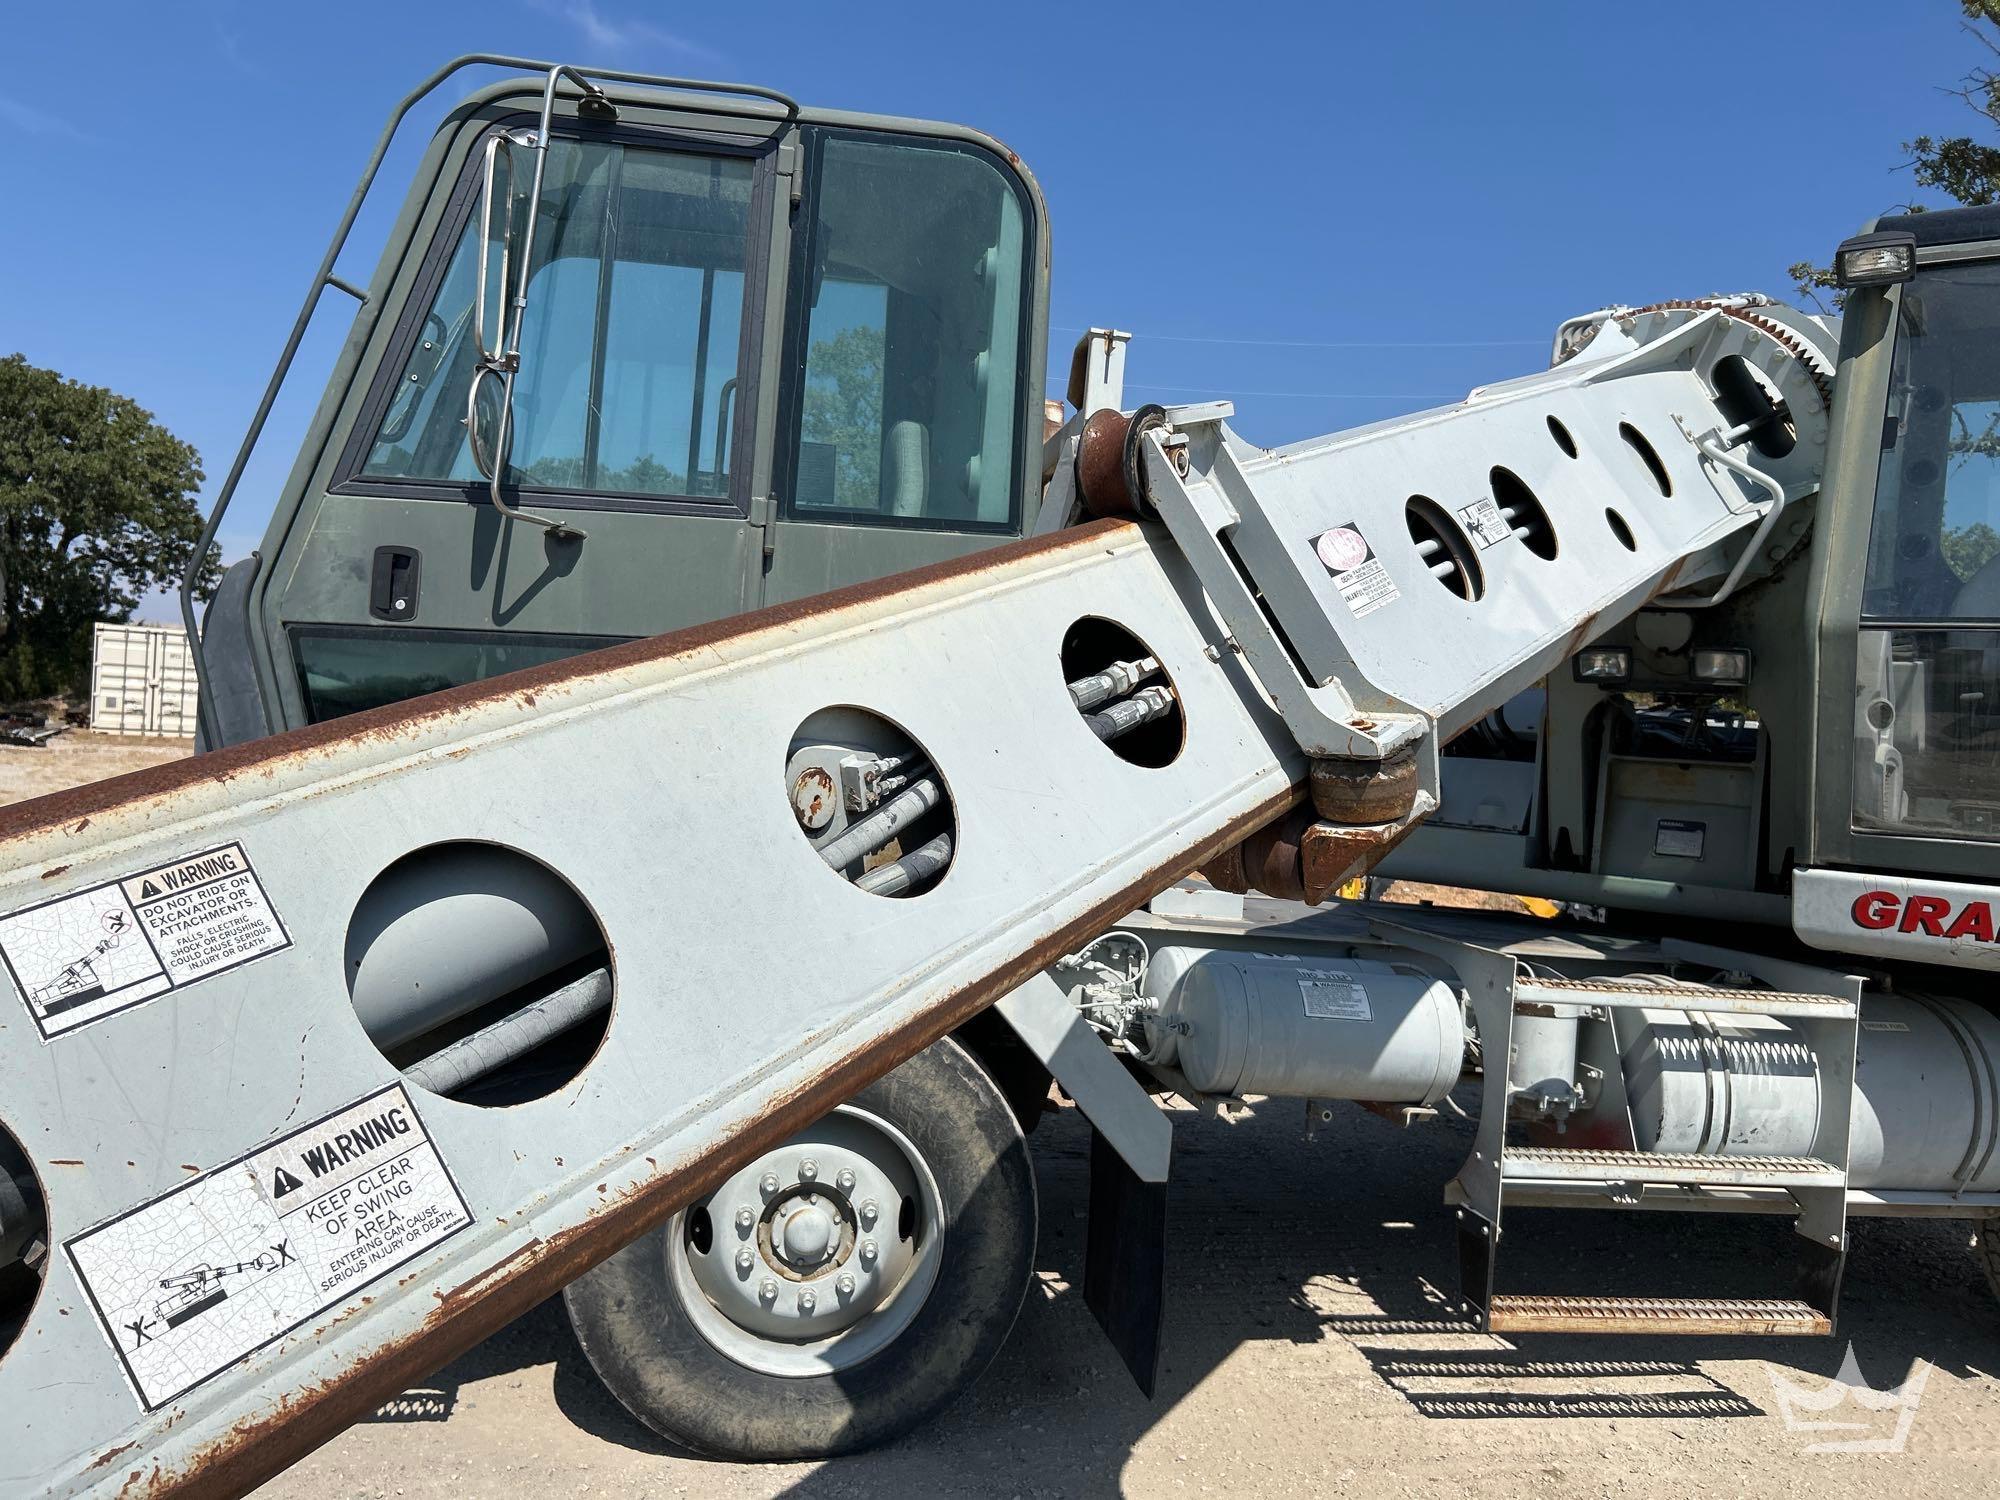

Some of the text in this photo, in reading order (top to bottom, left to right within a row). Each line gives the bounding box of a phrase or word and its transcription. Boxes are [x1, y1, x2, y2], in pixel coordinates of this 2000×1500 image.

[160, 853, 237, 890] WARNING
[144, 876, 250, 918] DO NOT RIDE ON
[150, 888, 248, 928] EXCAVATOR OR
[1851, 891, 2000, 943] GRA
[159, 900, 258, 938] ATTACHMENTS.
[170, 919, 264, 957] SHOCK OR CRUSHING
[208, 915, 250, 935] ELECTRIC
[170, 926, 271, 967] COULD CAUSE SERIOUS
[188, 954, 220, 970] INJURY
[222, 948, 236, 958] OR
[237, 938, 265, 952] DEATH
[301, 1108, 410, 1178] WARNING
[306, 1157, 413, 1223] KEEP CLEAR
[326, 1180, 412, 1234] OF SWING
[330, 1237, 383, 1272] ENTERING
[384, 1224, 405, 1240] CAN
[407, 1205, 439, 1228] CAUSE
[355, 1210, 404, 1244] AREA.
[321, 1261, 368, 1291] SERIOUS
[369, 1238, 404, 1264] INJURY
[406, 1230, 421, 1242] OR
[422, 1210, 457, 1232] DEATH.
